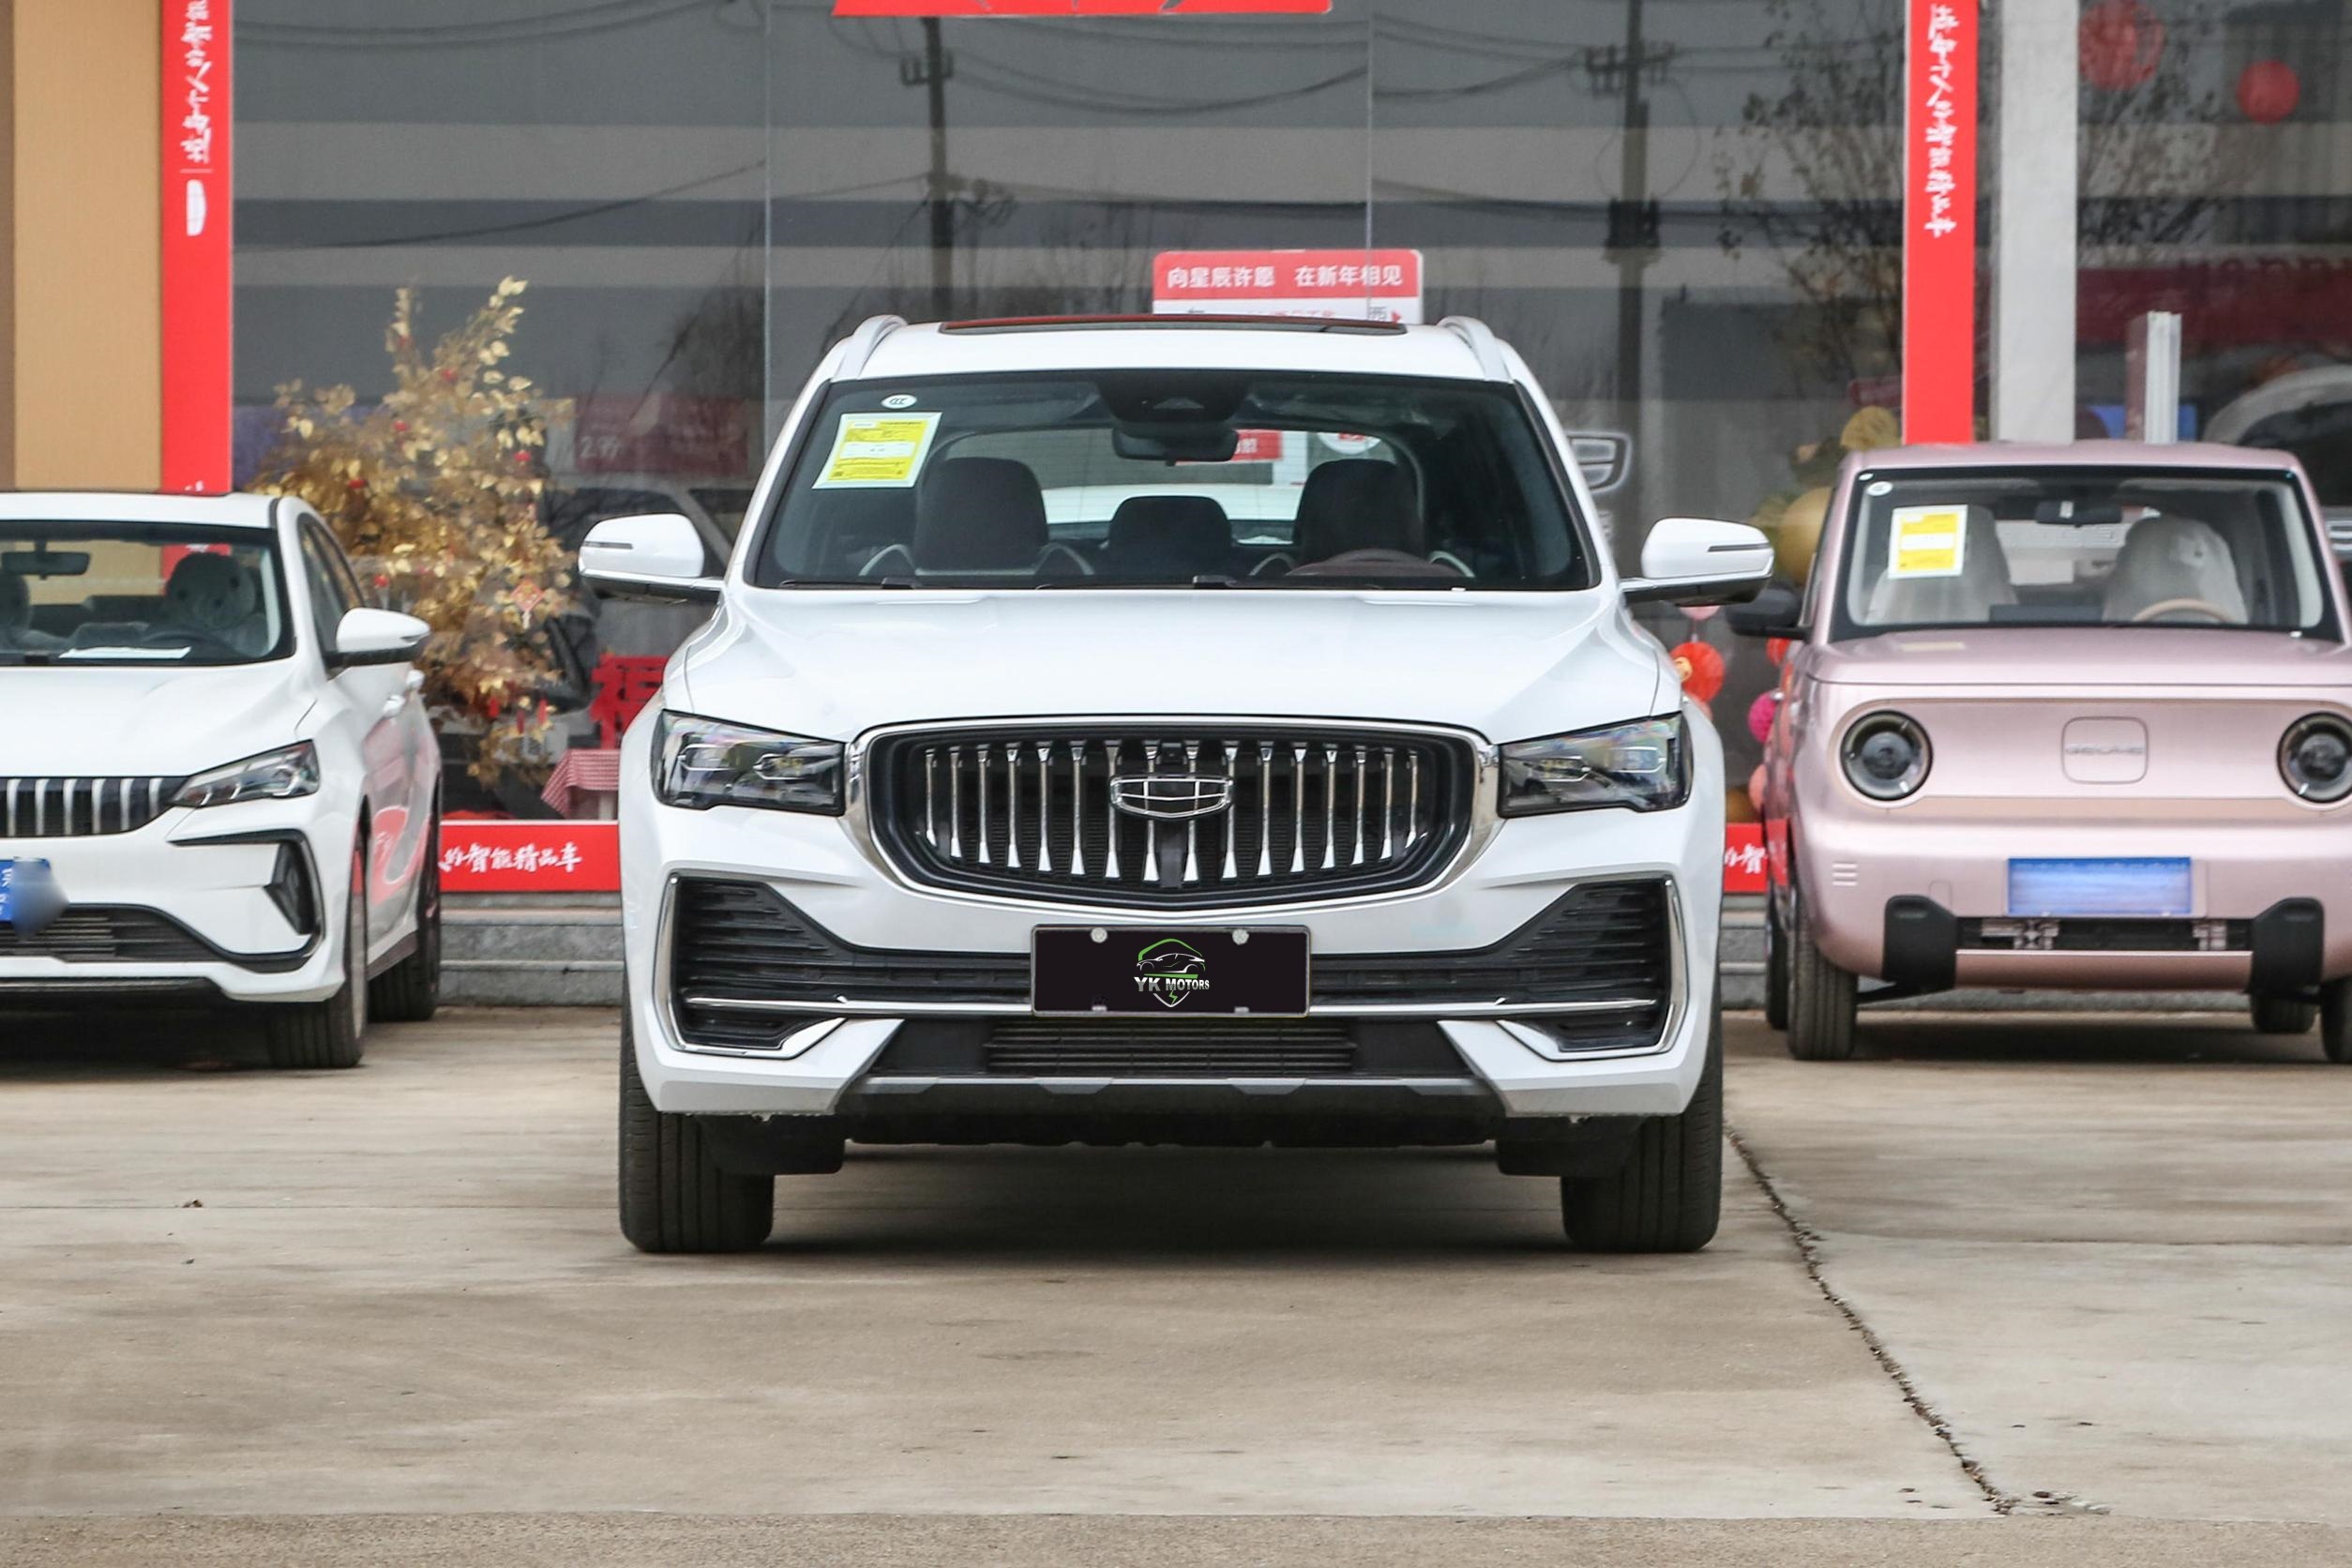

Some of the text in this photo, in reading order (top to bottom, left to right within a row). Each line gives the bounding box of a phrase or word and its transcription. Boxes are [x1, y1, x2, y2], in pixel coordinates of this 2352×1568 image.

[1167, 264, 1403, 289] 向星辰许愿 在新年相见
